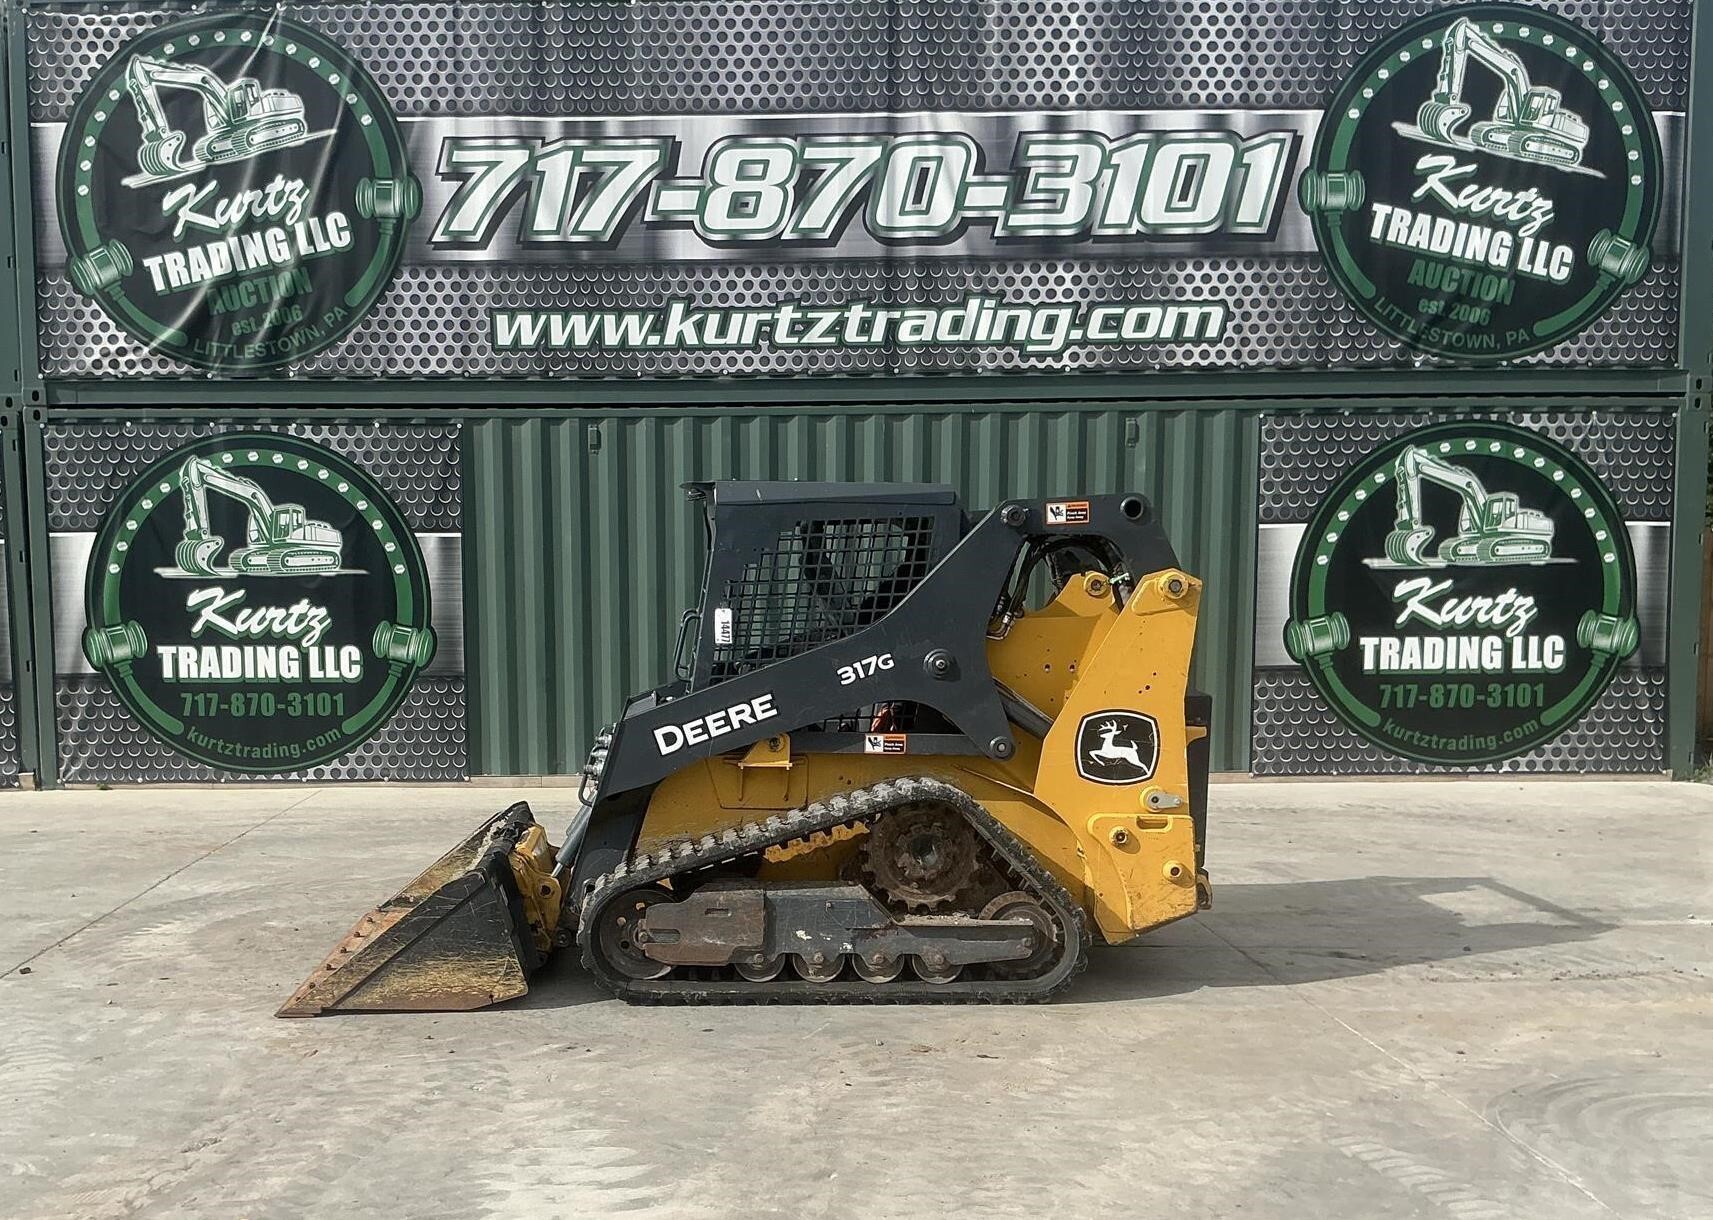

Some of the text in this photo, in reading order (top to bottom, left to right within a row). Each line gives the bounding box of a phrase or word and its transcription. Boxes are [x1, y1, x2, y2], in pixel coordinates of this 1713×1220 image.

[436, 134, 1289, 241] 717-870-3101
[1412, 154, 1555, 237] Kurtz
[162, 174, 311, 240] Kurtz
[143, 212, 353, 294] TRADING LLC
[1370, 203, 1576, 284] TRADING LLC
[206, 267, 313, 315] AUCTION
[1407, 258, 1516, 306] AUCTION
[262, 304, 303, 329] 2006
[323, 306, 348, 328] PA
[493, 297, 1227, 354] www.kurtztrading.com
[1450, 303, 1491, 326] 2006
[1506, 328, 1531, 346] PA
[187, 587, 331, 646] Kurtz
[1393, 577, 1537, 637] Kurtz
[720, 620, 731, 643] 14477
[156, 645, 364, 682] TRADING LLC
[836, 653, 895, 686] 317G
[1360, 635, 1566, 673] TRADING LLC
[180, 692, 345, 718] 717-870-3101
[1379, 683, 1545, 709] 717-870-3101
[186, 726, 342, 759] kurtztrading.com
[653, 693, 779, 756] DEERE
[1382, 718, 1539, 751] kurtztrading.com
